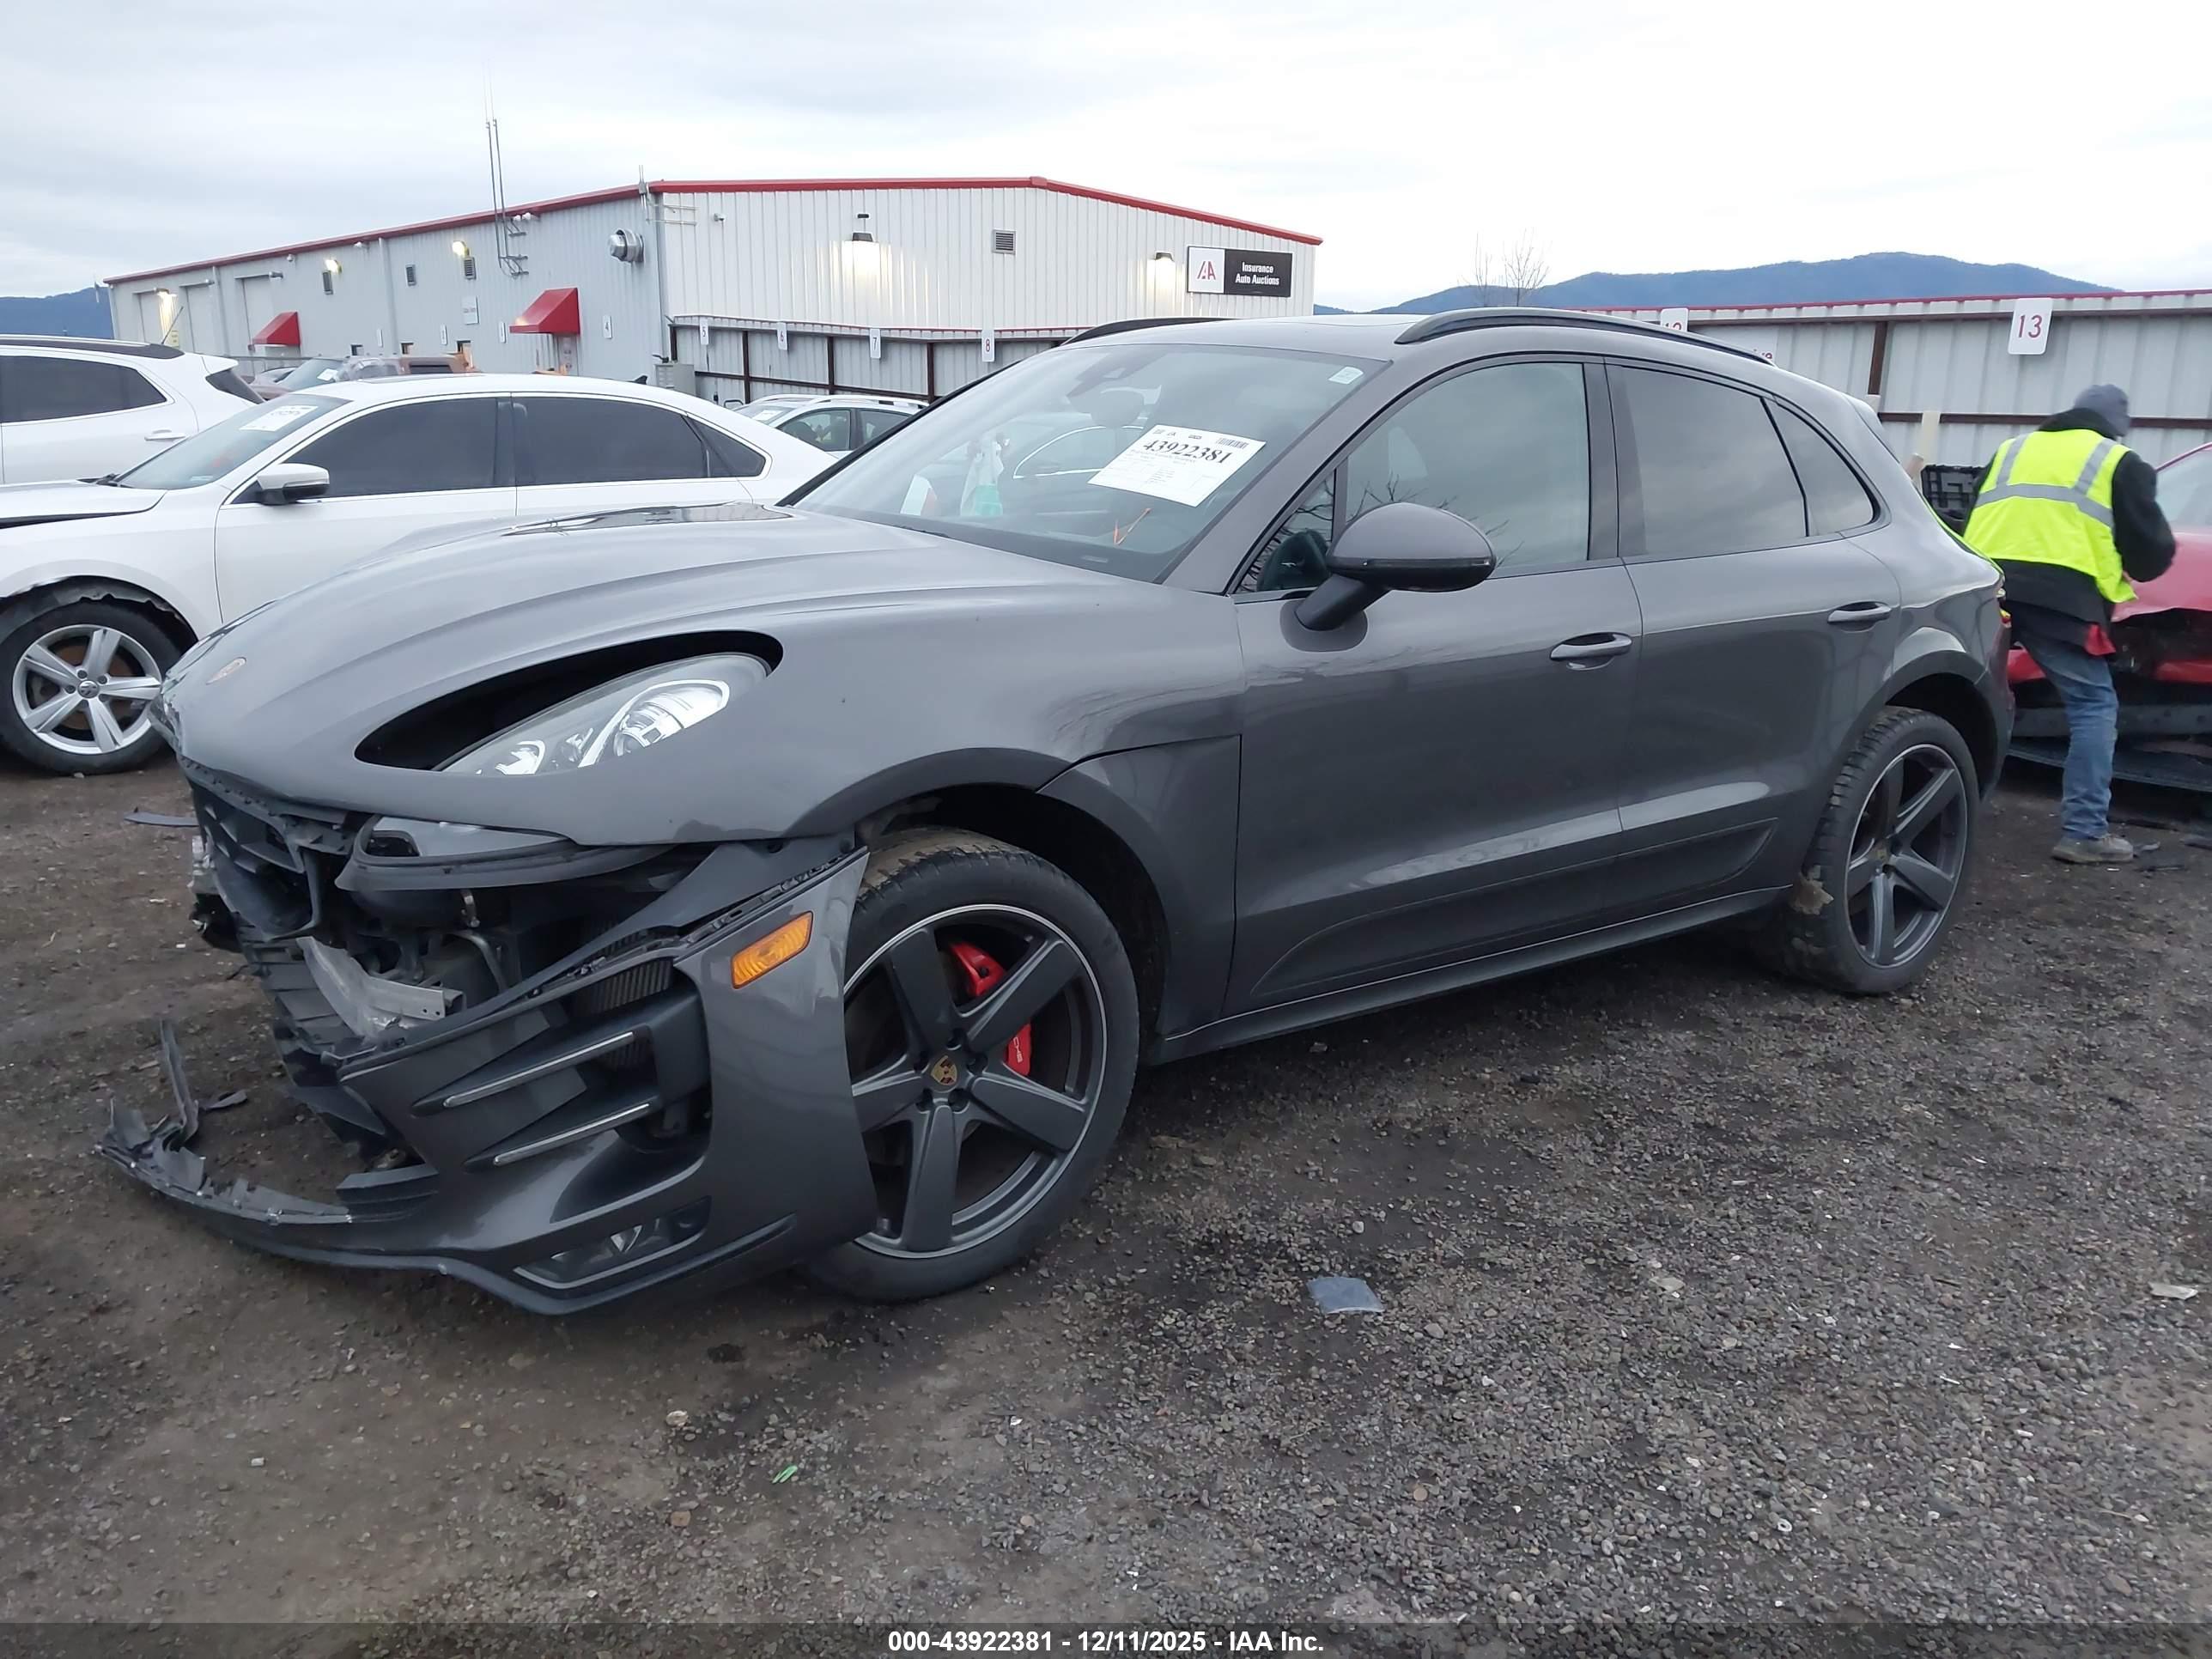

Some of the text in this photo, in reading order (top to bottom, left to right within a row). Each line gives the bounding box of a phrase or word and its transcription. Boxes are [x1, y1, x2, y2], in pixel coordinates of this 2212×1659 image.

[1243, 262, 1273, 273] Insurance
[1236, 273, 1279, 285] Auto Auctions
[2018, 314, 2043, 338] 13
[872, 337, 878, 350] 7
[985, 338, 991, 352] 8
[1143, 439, 1233, 464] 43922381
